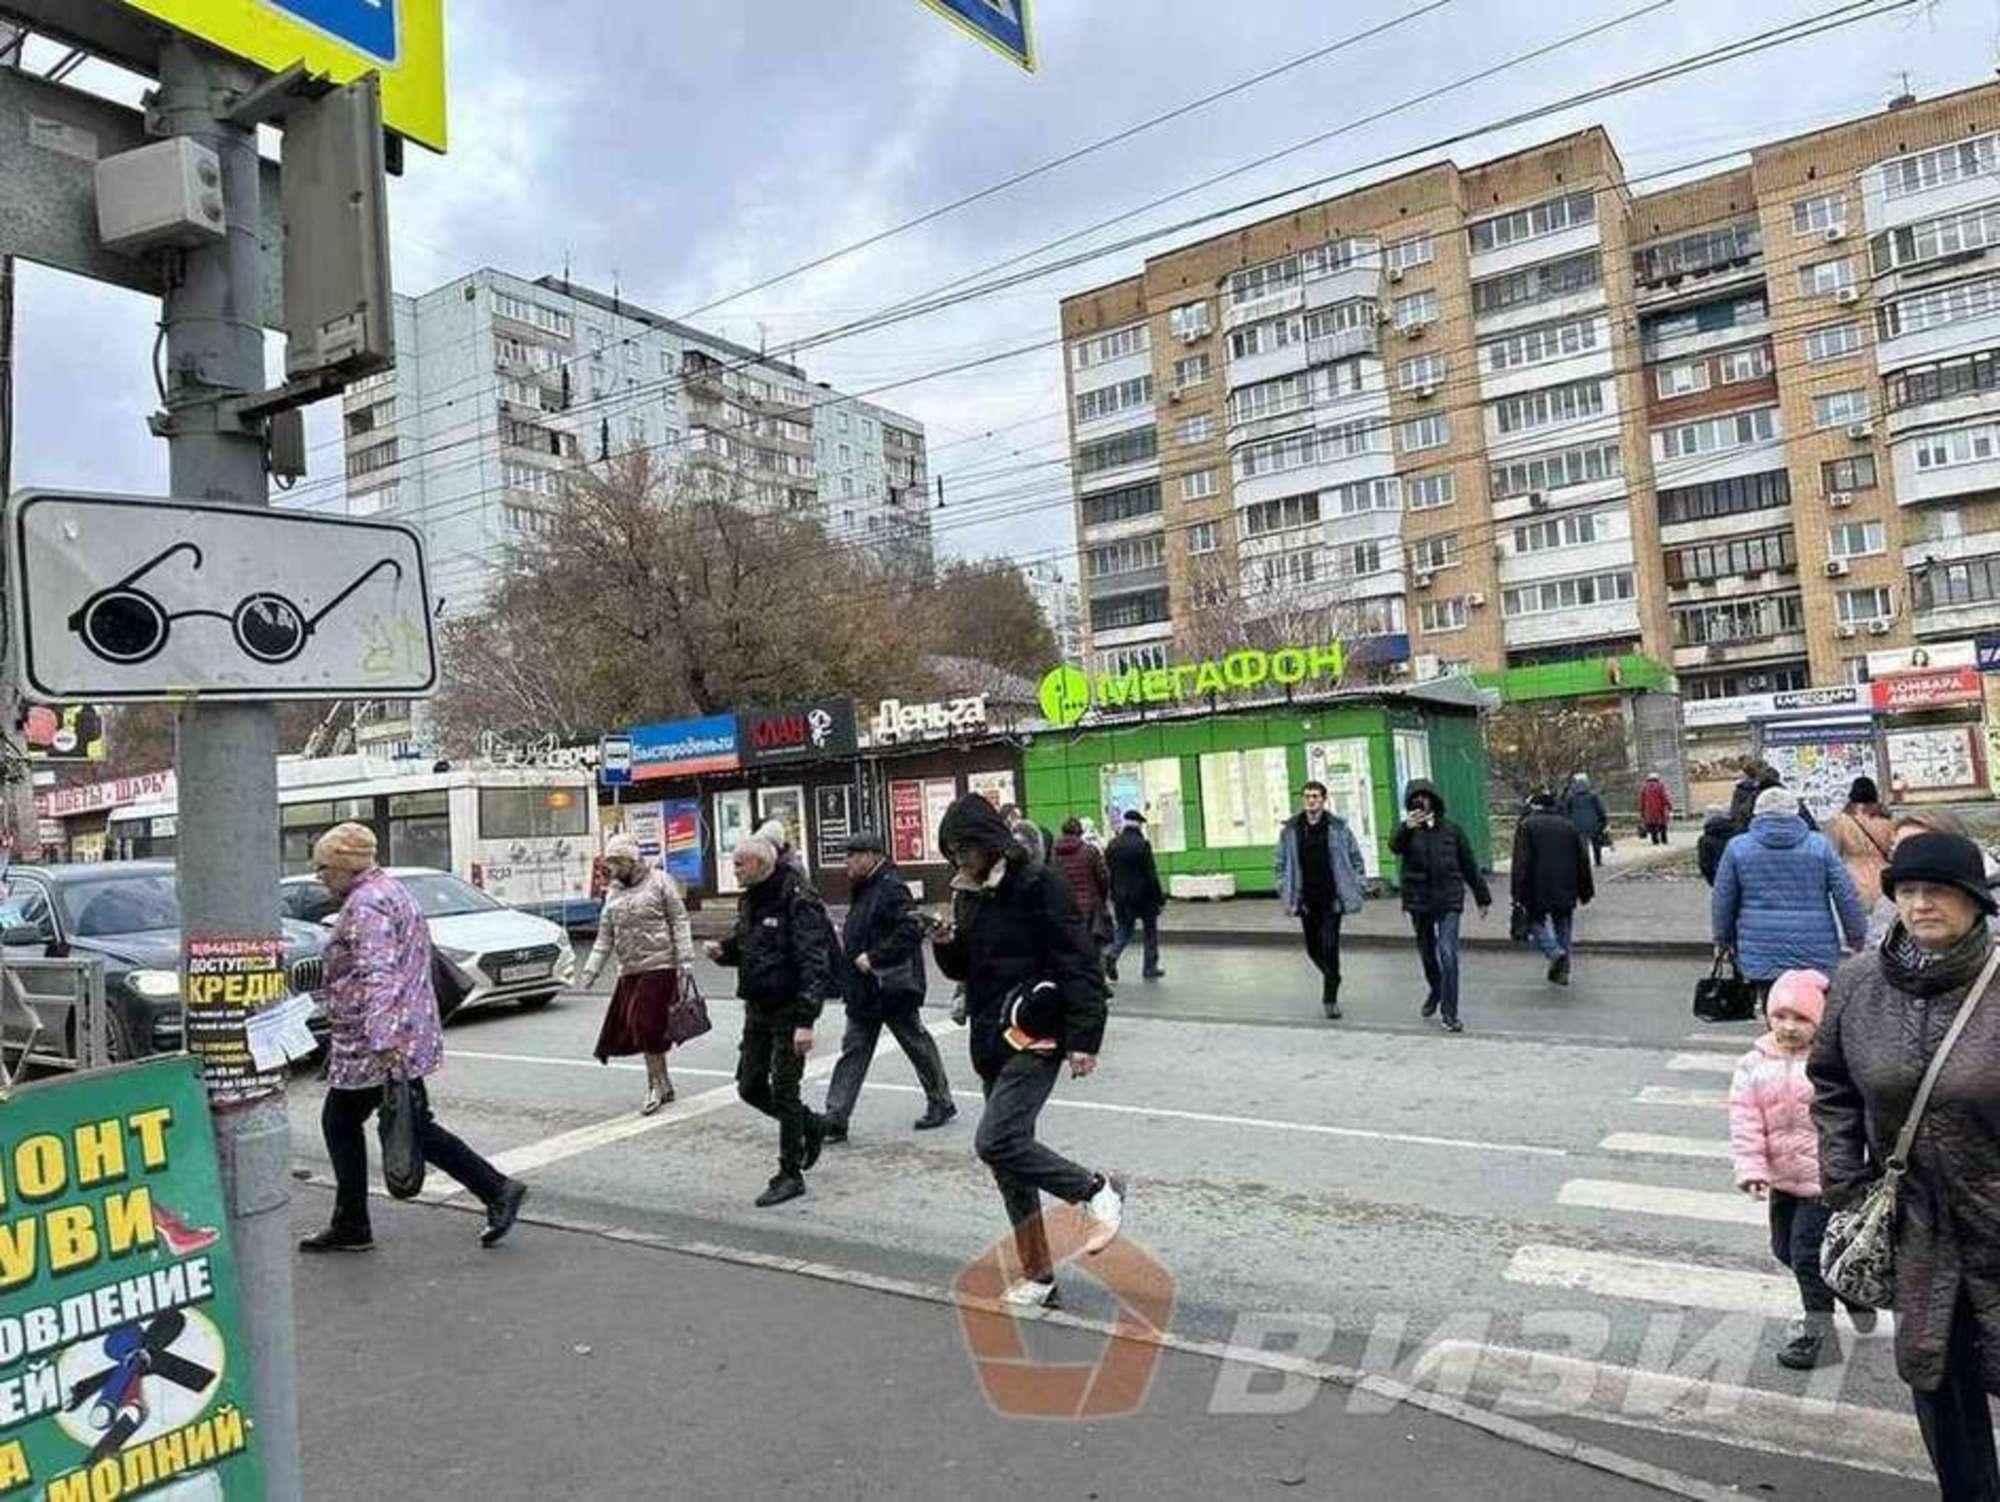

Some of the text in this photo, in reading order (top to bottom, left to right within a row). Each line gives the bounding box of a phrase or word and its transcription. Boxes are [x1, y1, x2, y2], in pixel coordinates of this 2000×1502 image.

[1097, 641, 1346, 705] МЕГАФОН
[879, 693, 990, 738] Деньга
[115, 774, 168, 801] ШАРЫ
[0, 1107, 172, 1200] ОНТ
[48, 1403, 245, 1502] МОЛНИЙ
